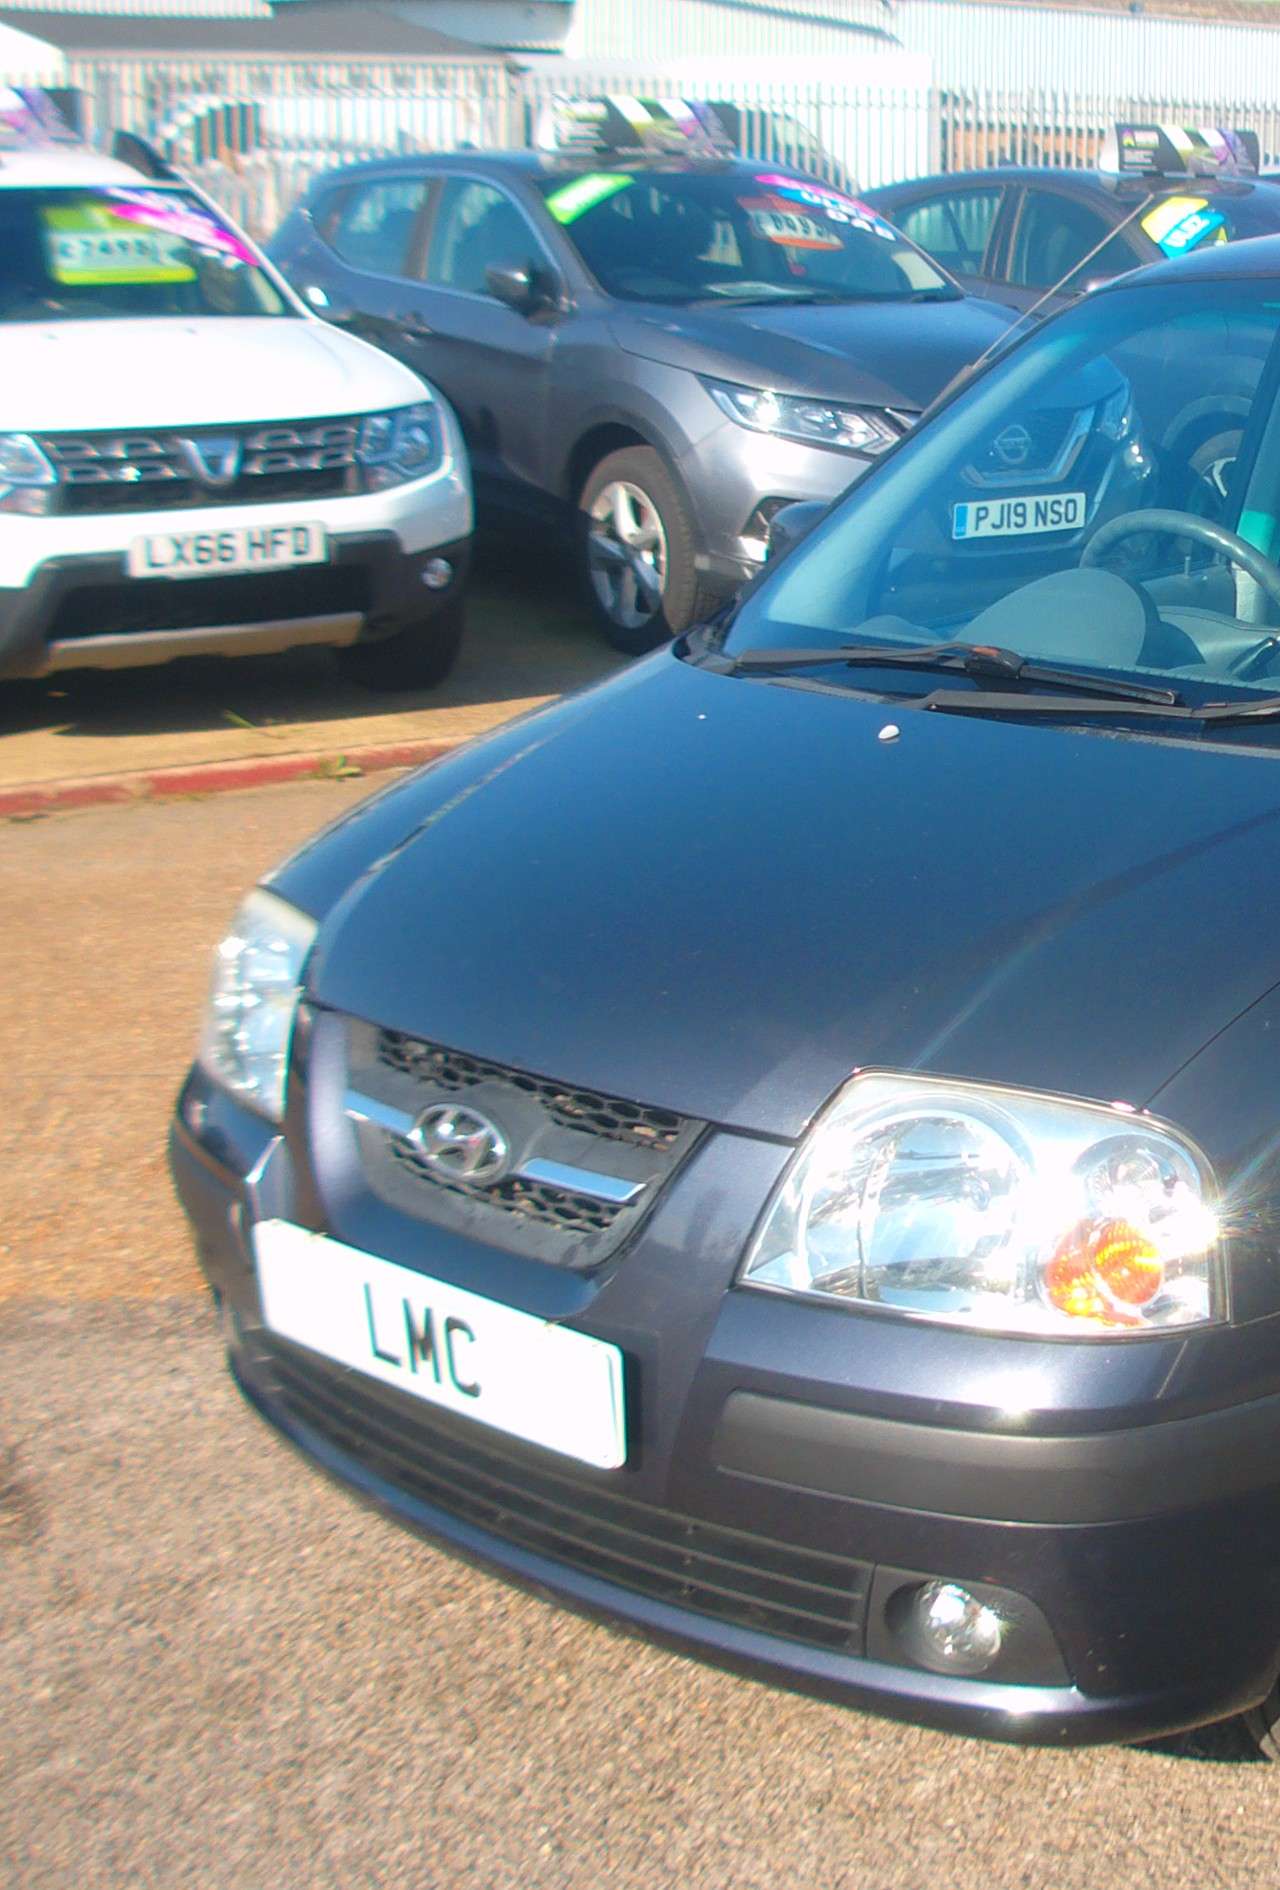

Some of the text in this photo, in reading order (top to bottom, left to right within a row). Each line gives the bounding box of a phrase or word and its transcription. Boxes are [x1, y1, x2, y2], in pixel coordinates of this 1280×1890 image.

[974, 498, 1077, 531] PJ19 NSO
[145, 526, 310, 568] LX66 HFD
[363, 1281, 482, 1399] LMC
